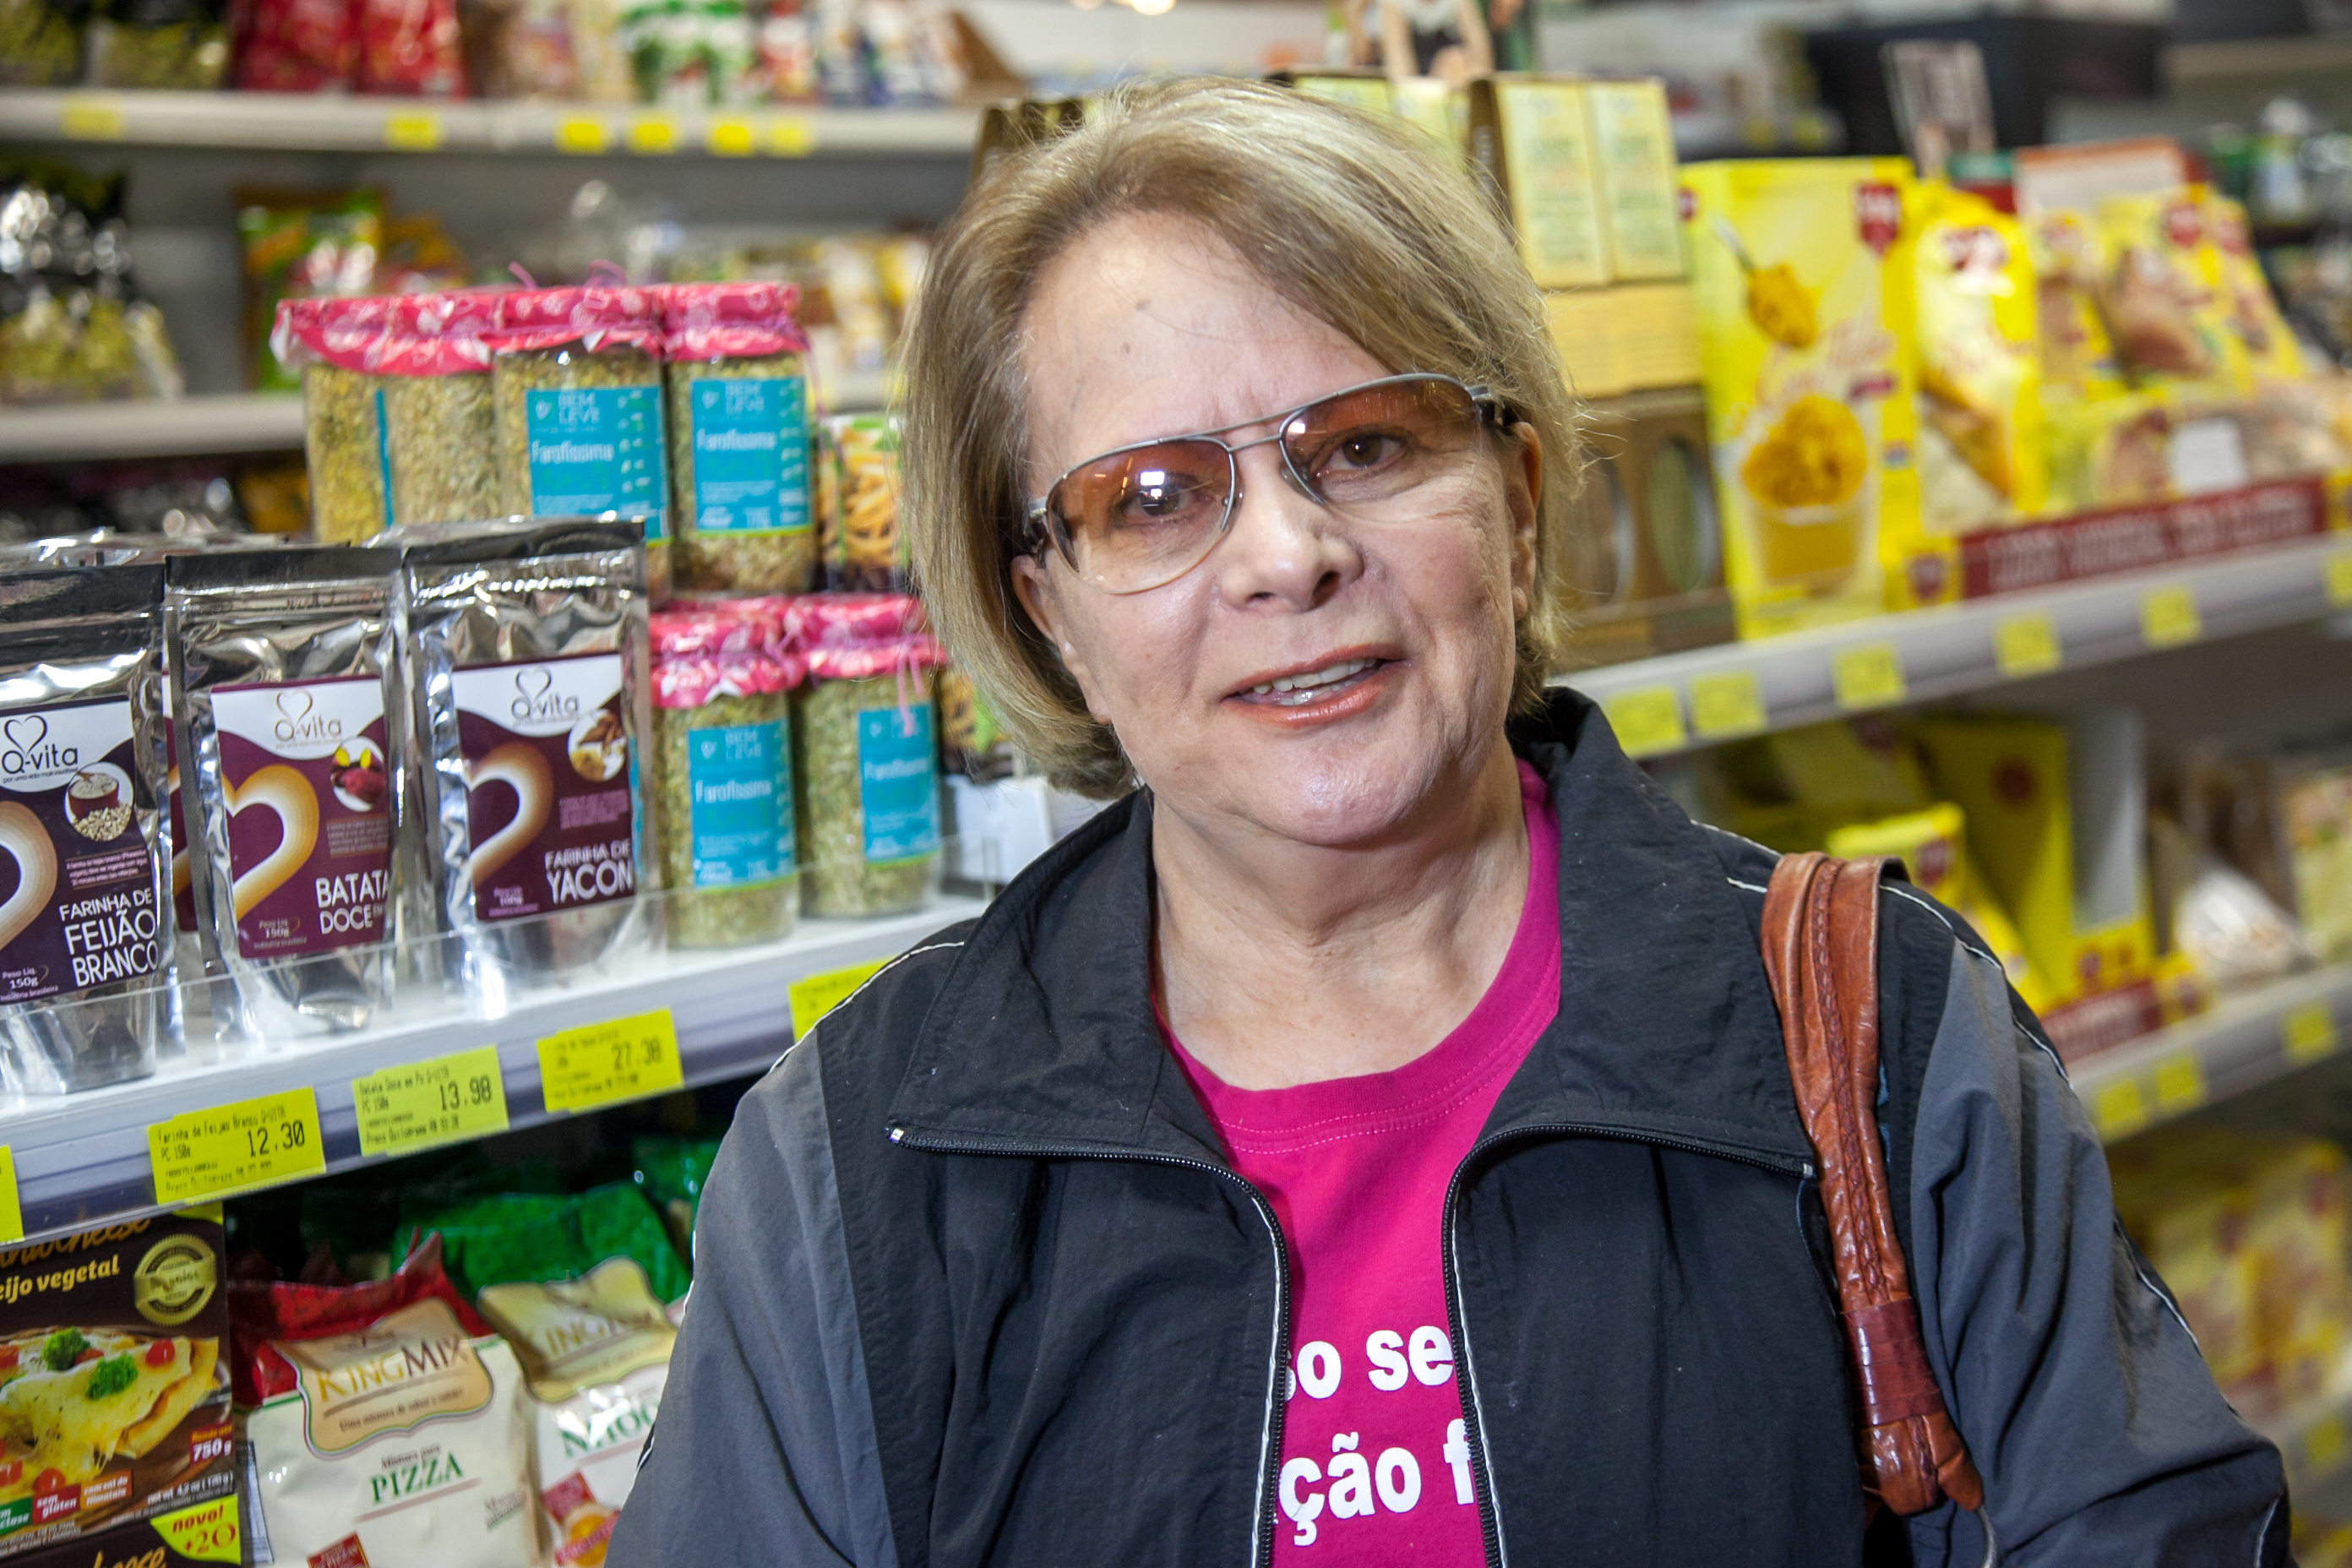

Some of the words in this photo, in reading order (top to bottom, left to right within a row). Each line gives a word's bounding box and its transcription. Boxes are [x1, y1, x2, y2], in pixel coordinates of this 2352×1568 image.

[2, 743, 78, 774] Q-vita
[545, 842, 609, 871] FARINHA
[610, 838, 631, 860] DE
[547, 858, 634, 905] YACON
[59, 893, 131, 922] FARINHA
[133, 887, 154, 907] DE
[320, 904, 373, 934] DOCE
[64, 908, 156, 956] FEIJÃO
[72, 939, 159, 988] BRANCO
[439, 1073, 493, 1112] 13.98
[247, 1118, 306, 1158] 12.30
[36, 1254, 120, 1293] vegetal
[1365, 1325, 1454, 1391] se
[193, 1437, 222, 1462] 750
[369, 1451, 463, 1503] PIZZA
[1278, 1431, 1422, 1547] ção
[1442, 1418, 1475, 1505] f
[36, 1494, 58, 1510] sem
[172, 1501, 224, 1535] novo!
